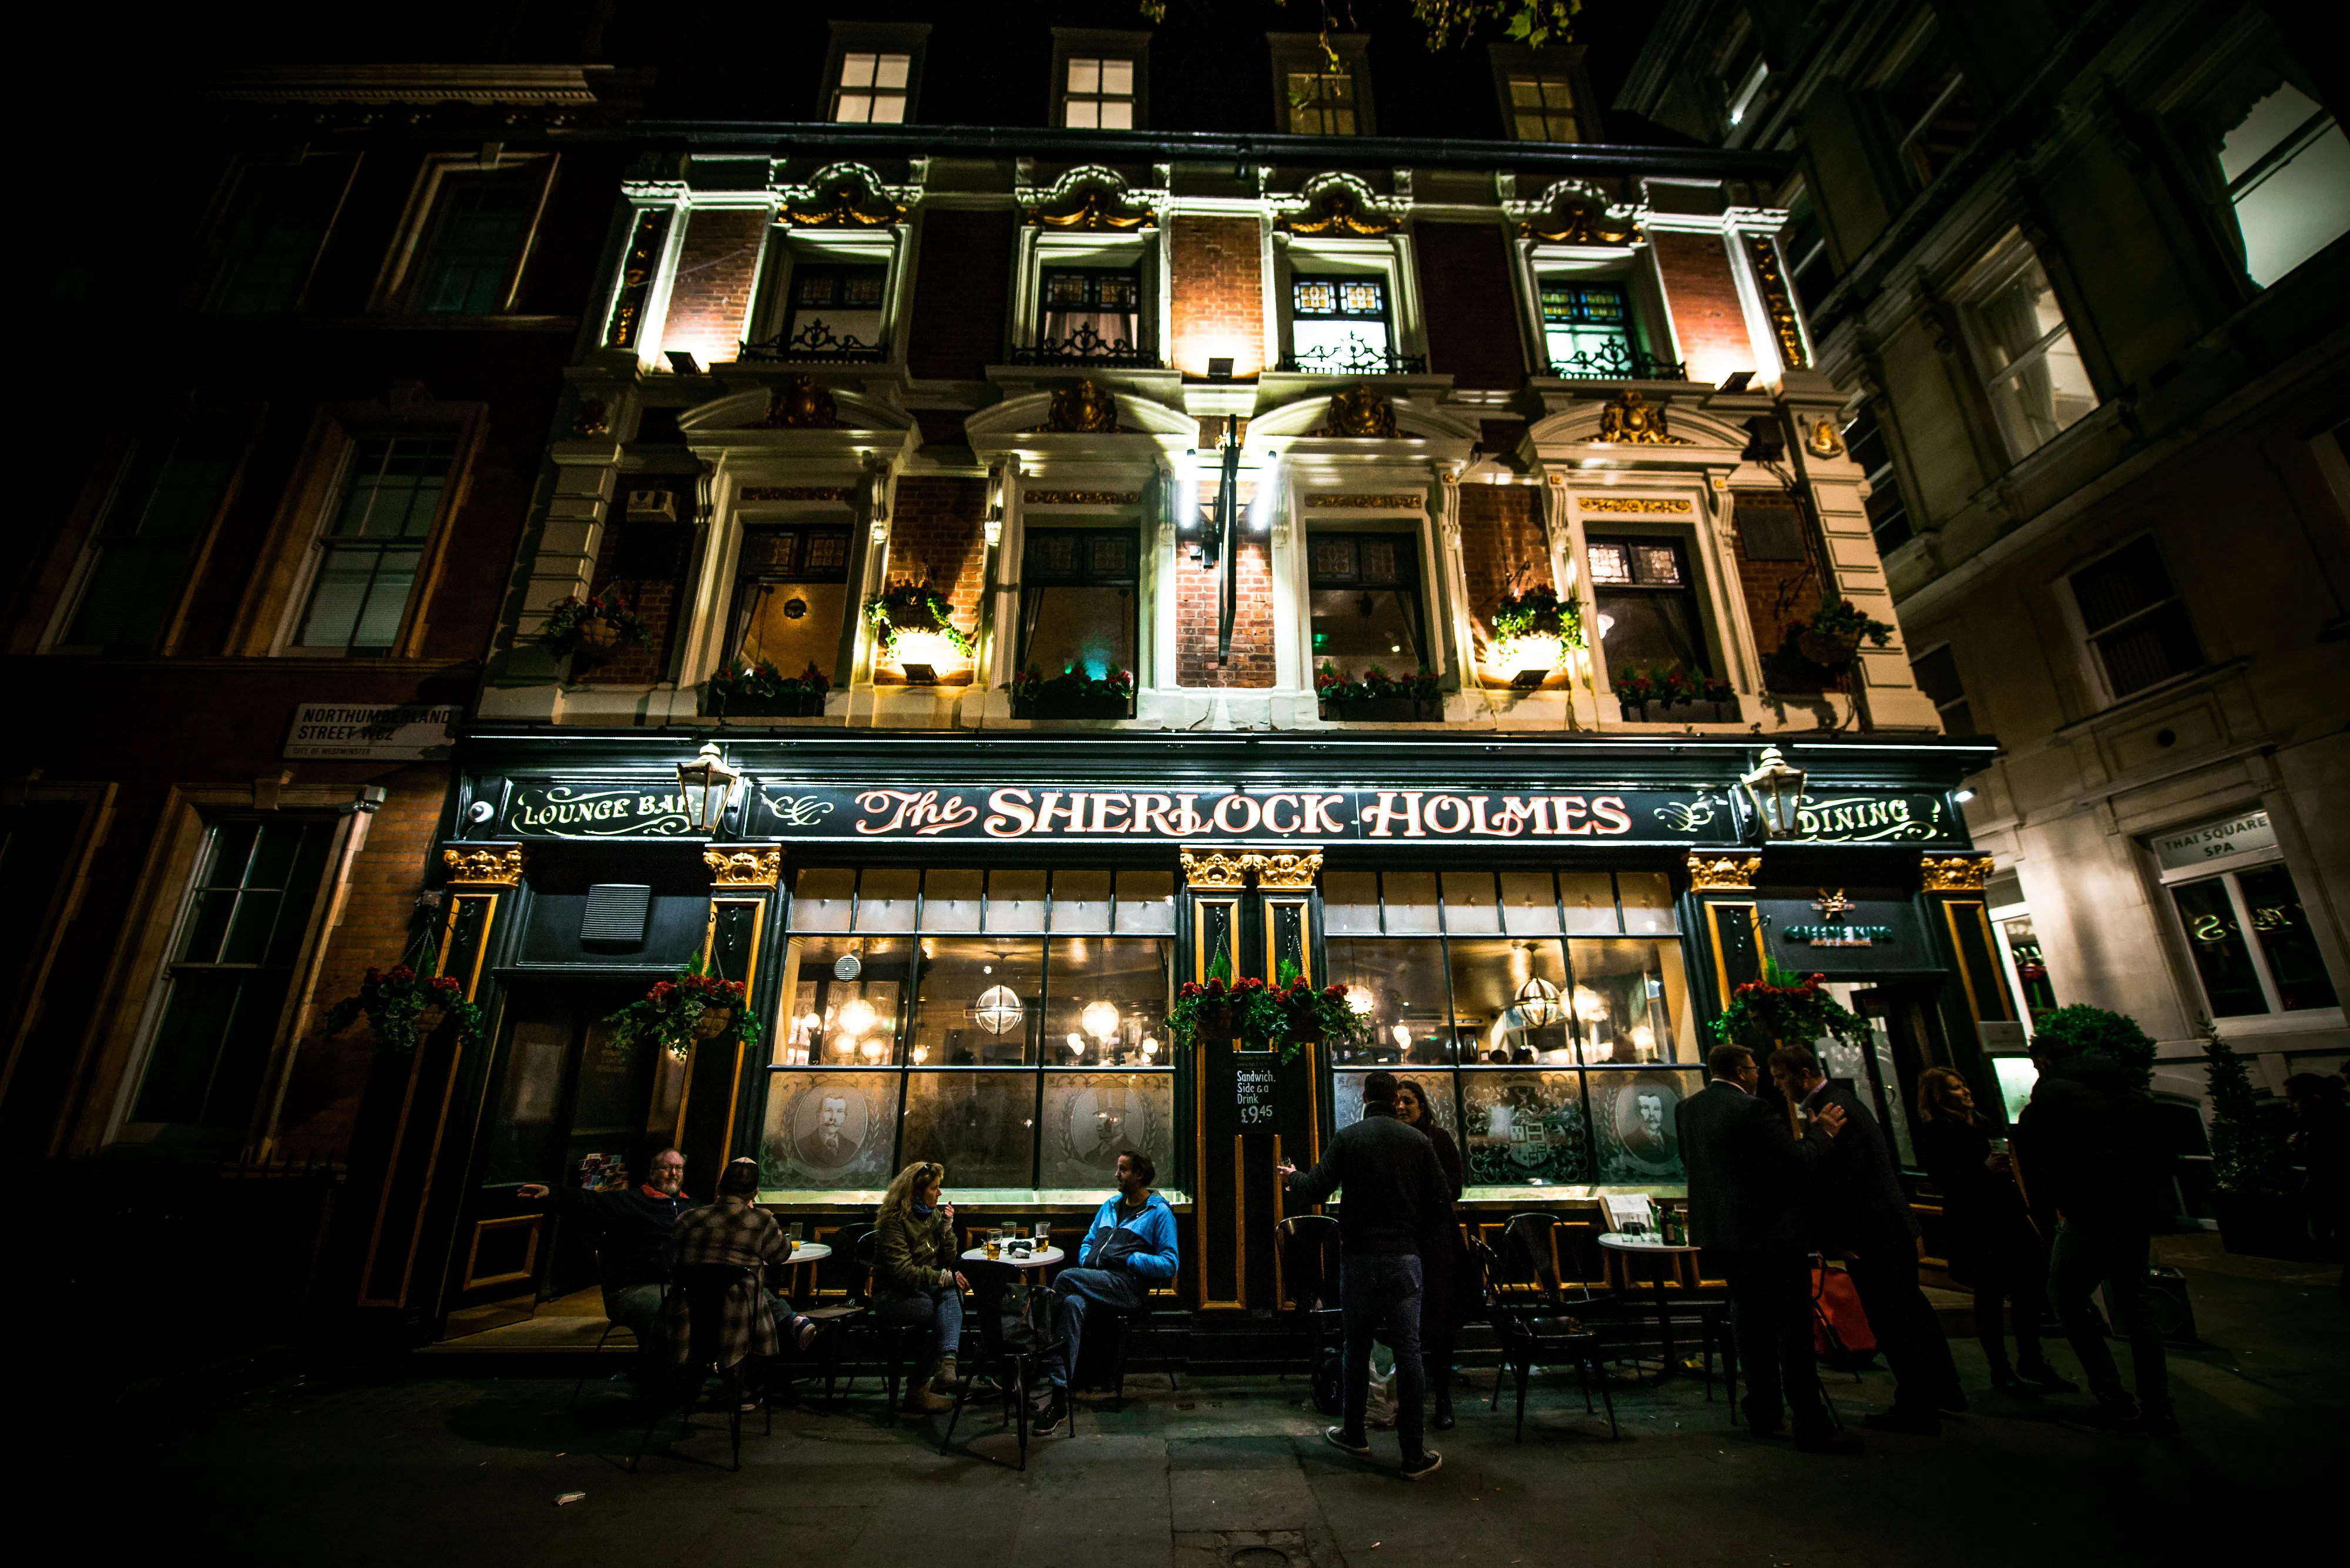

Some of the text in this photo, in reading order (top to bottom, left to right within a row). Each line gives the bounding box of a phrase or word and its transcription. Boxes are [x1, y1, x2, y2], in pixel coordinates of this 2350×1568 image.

[302, 709, 450, 724] NORTHUMBERLAND
[298, 726, 356, 740] STREET
[524, 794, 694, 825] LOUNGE BAR
[855, 788, 1631, 837] The SHERLOCK HOLMES
[1797, 799, 1910, 833] DINING
[2165, 817, 2268, 850] THAI SQUARE
[2205, 842, 2235, 857] SPA
[1784, 925, 1895, 939] GREENE KING
[1237, 1082, 1255, 1093] Side
[1263, 1084, 1269, 1093] a
[1237, 1093, 1259, 1104] Drink
